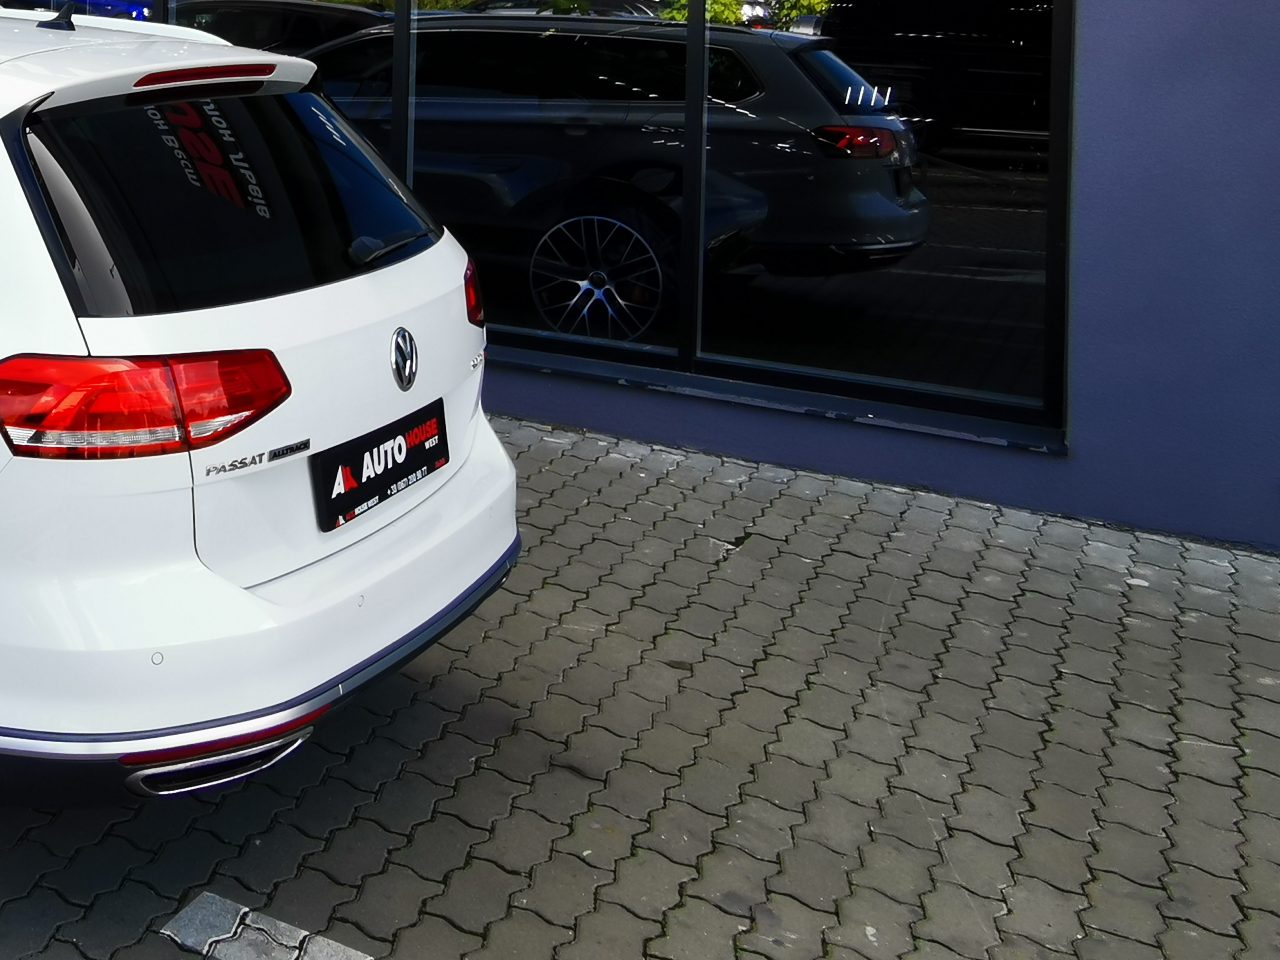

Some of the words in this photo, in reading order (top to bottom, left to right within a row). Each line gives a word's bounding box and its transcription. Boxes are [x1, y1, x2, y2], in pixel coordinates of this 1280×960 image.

[362, 435, 407, 483] AUTO
[406, 419, 438, 448] HOUSE
[424, 435, 438, 449] WEST
[206, 452, 265, 477] PASSAT
